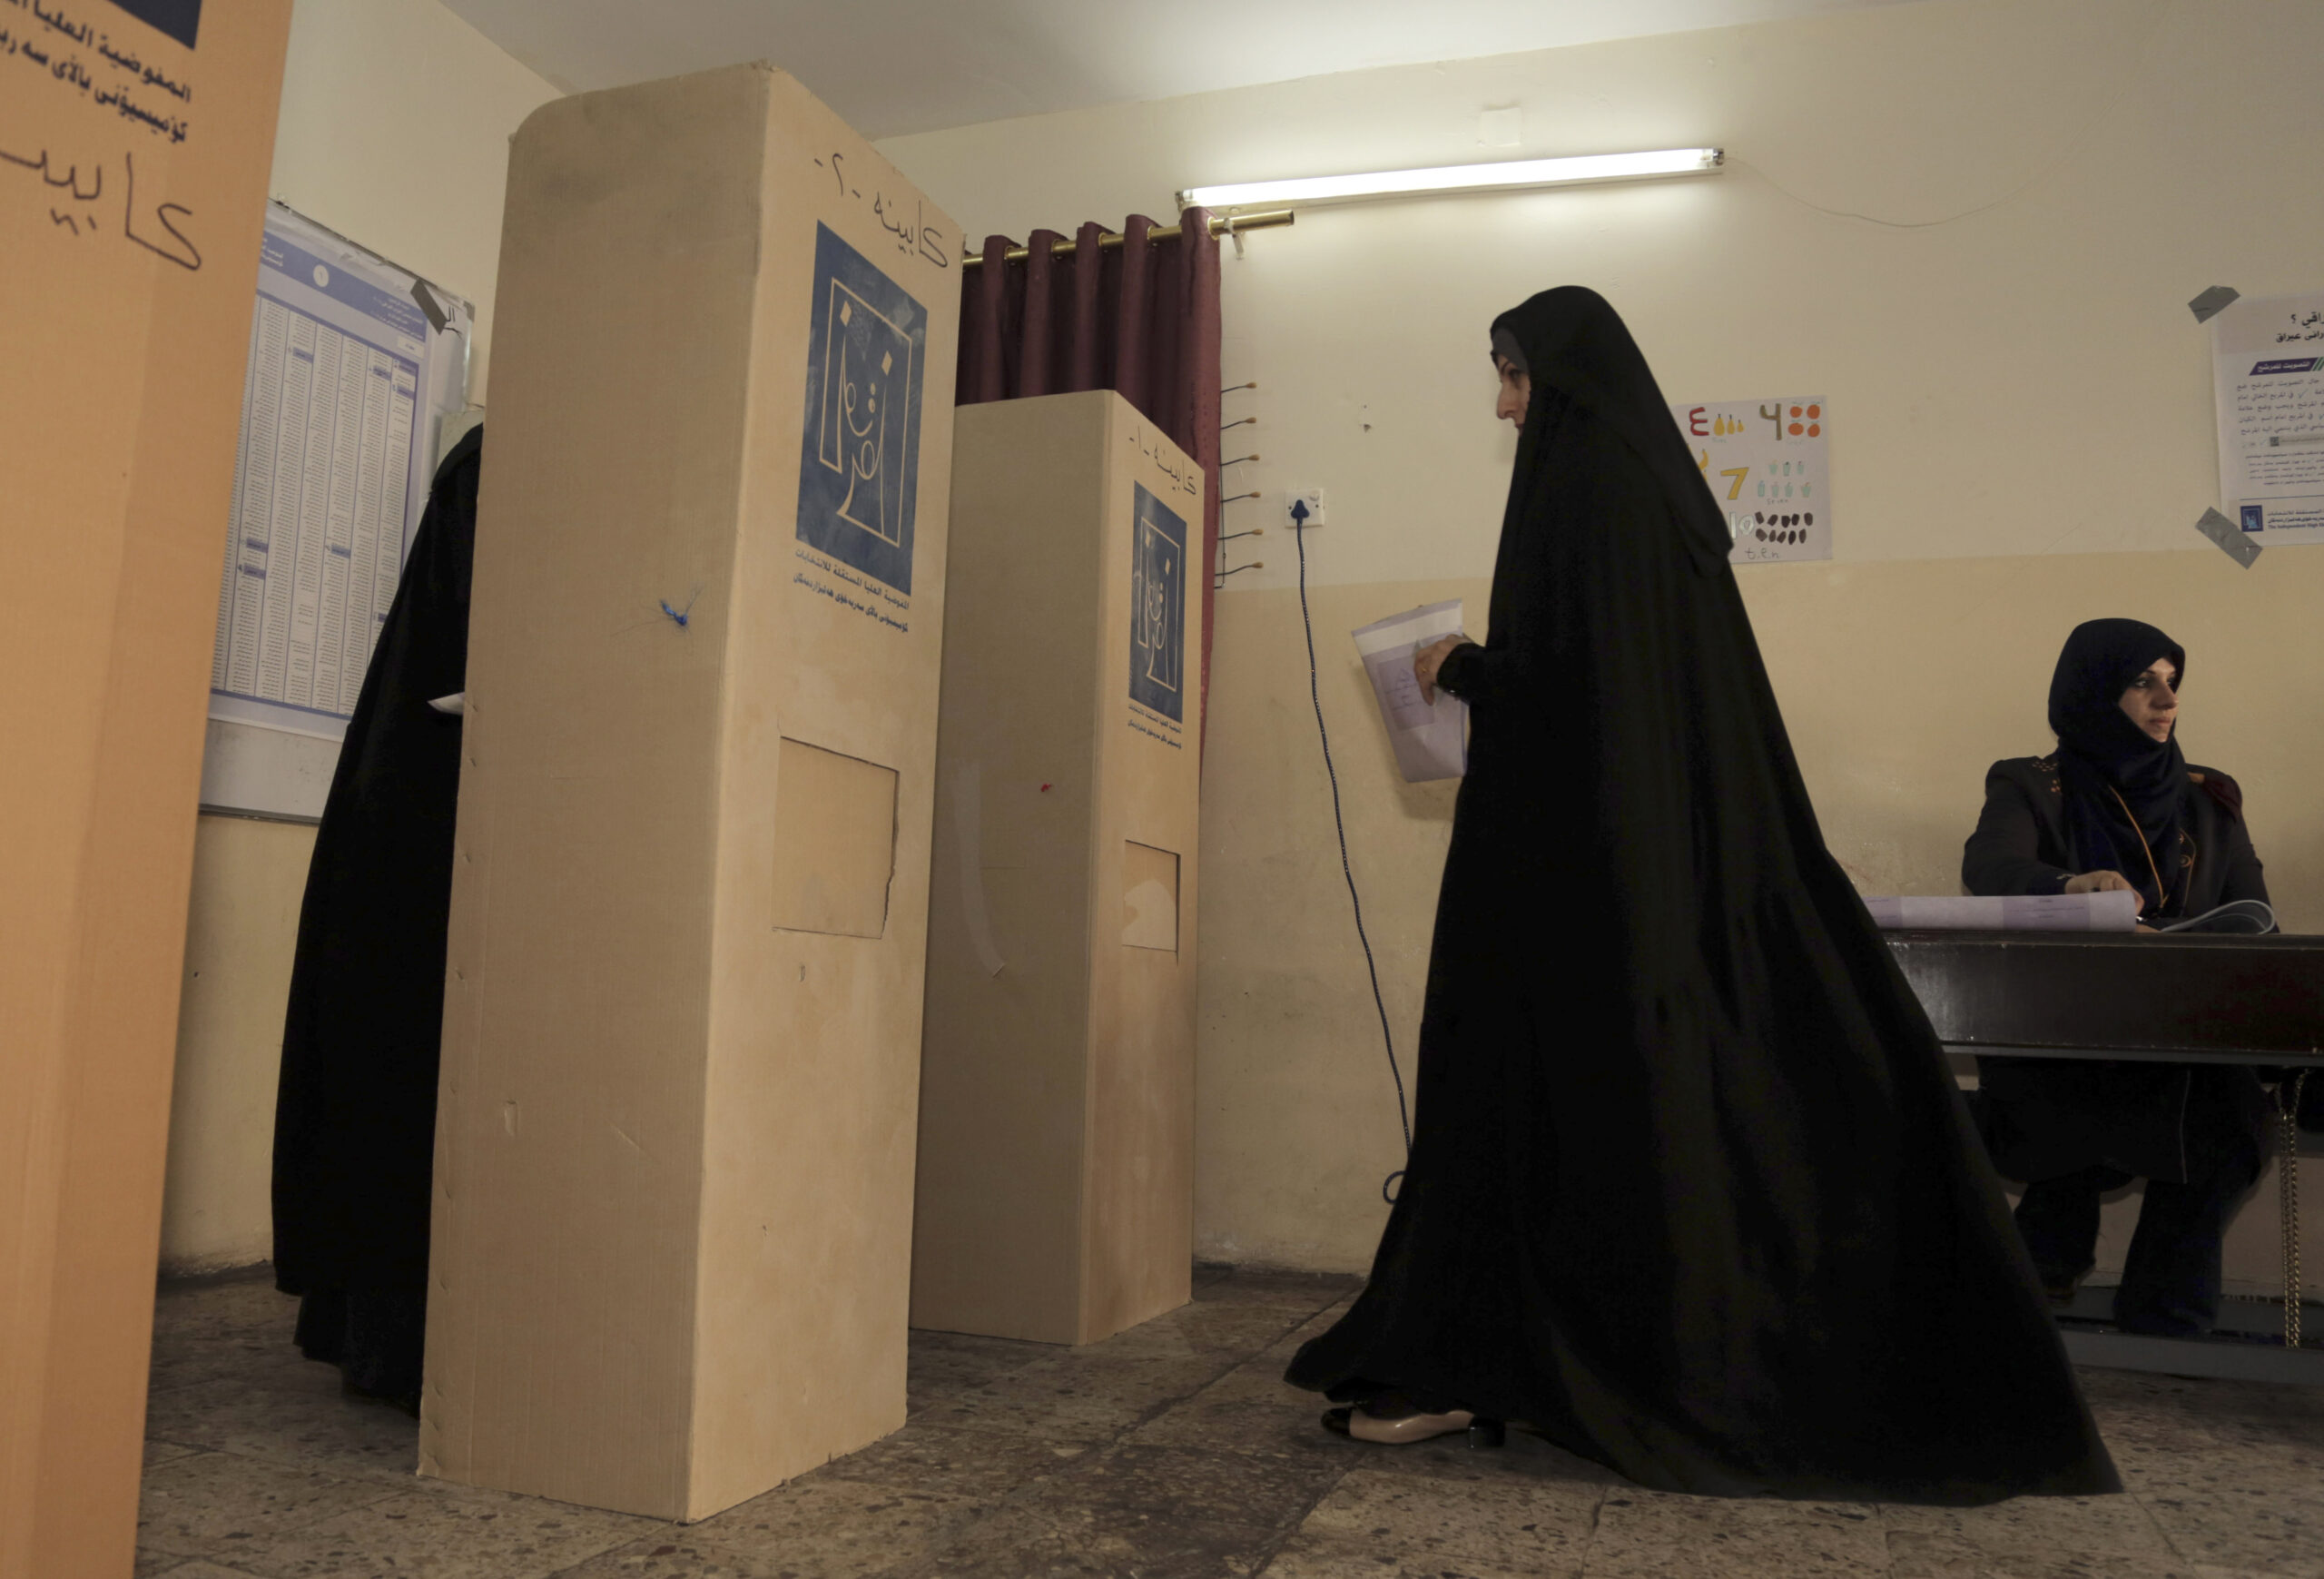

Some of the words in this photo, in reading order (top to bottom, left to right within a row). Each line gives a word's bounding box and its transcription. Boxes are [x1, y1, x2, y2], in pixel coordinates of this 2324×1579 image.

[34, 0, 94, 47] العليا
[98, 35, 192, 104] المفوضية
[1720, 467, 1749, 500] 7
